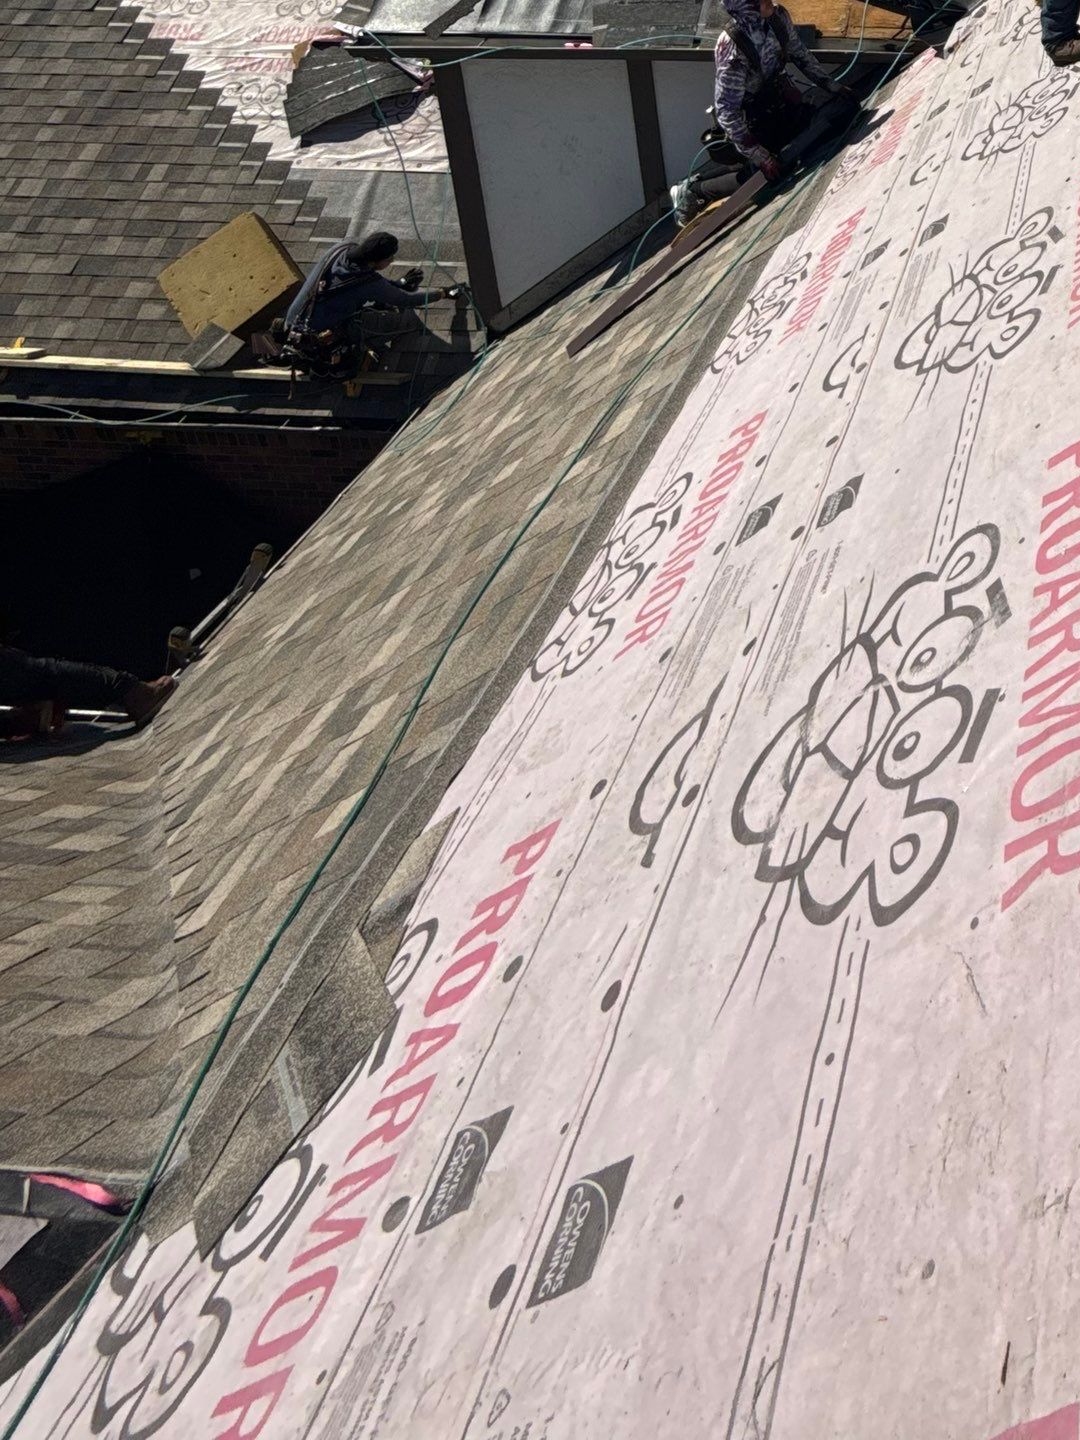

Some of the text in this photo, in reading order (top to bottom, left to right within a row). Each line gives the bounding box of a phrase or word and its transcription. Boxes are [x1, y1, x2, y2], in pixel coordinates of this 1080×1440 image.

[613, 409, 768, 661] PROARMOR
[426, 1131, 470, 1226] CORNING
[436, 1143, 476, 1220] OWENS
[539, 1186, 584, 1298] CORNING
[551, 1200, 591, 1294] OWENS
